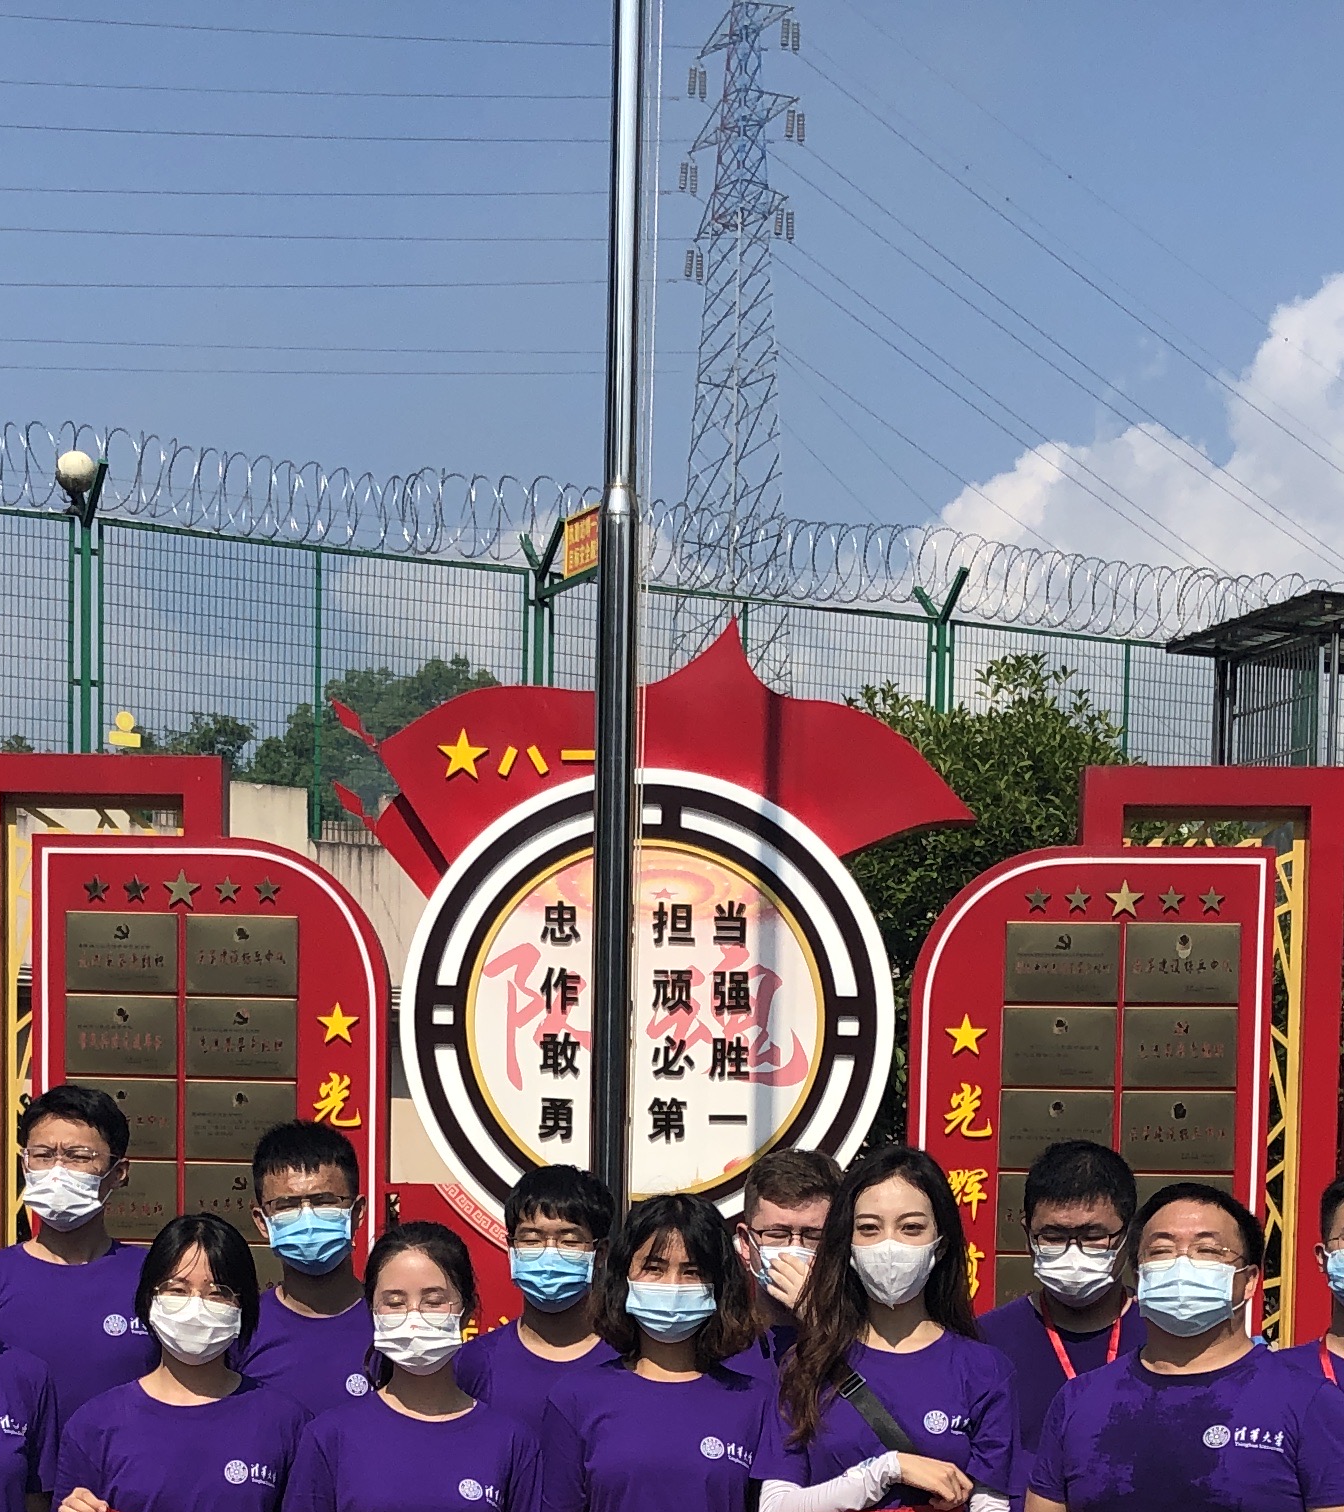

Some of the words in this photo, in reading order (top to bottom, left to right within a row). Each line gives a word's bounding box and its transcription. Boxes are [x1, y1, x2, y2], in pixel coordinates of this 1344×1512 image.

[540, 900, 747, 948] 忠担当
[540, 966, 752, 1017] 作顽强
[539, 1032, 750, 1082] 敢必胜
[538, 1097, 748, 1144] 勇第一
